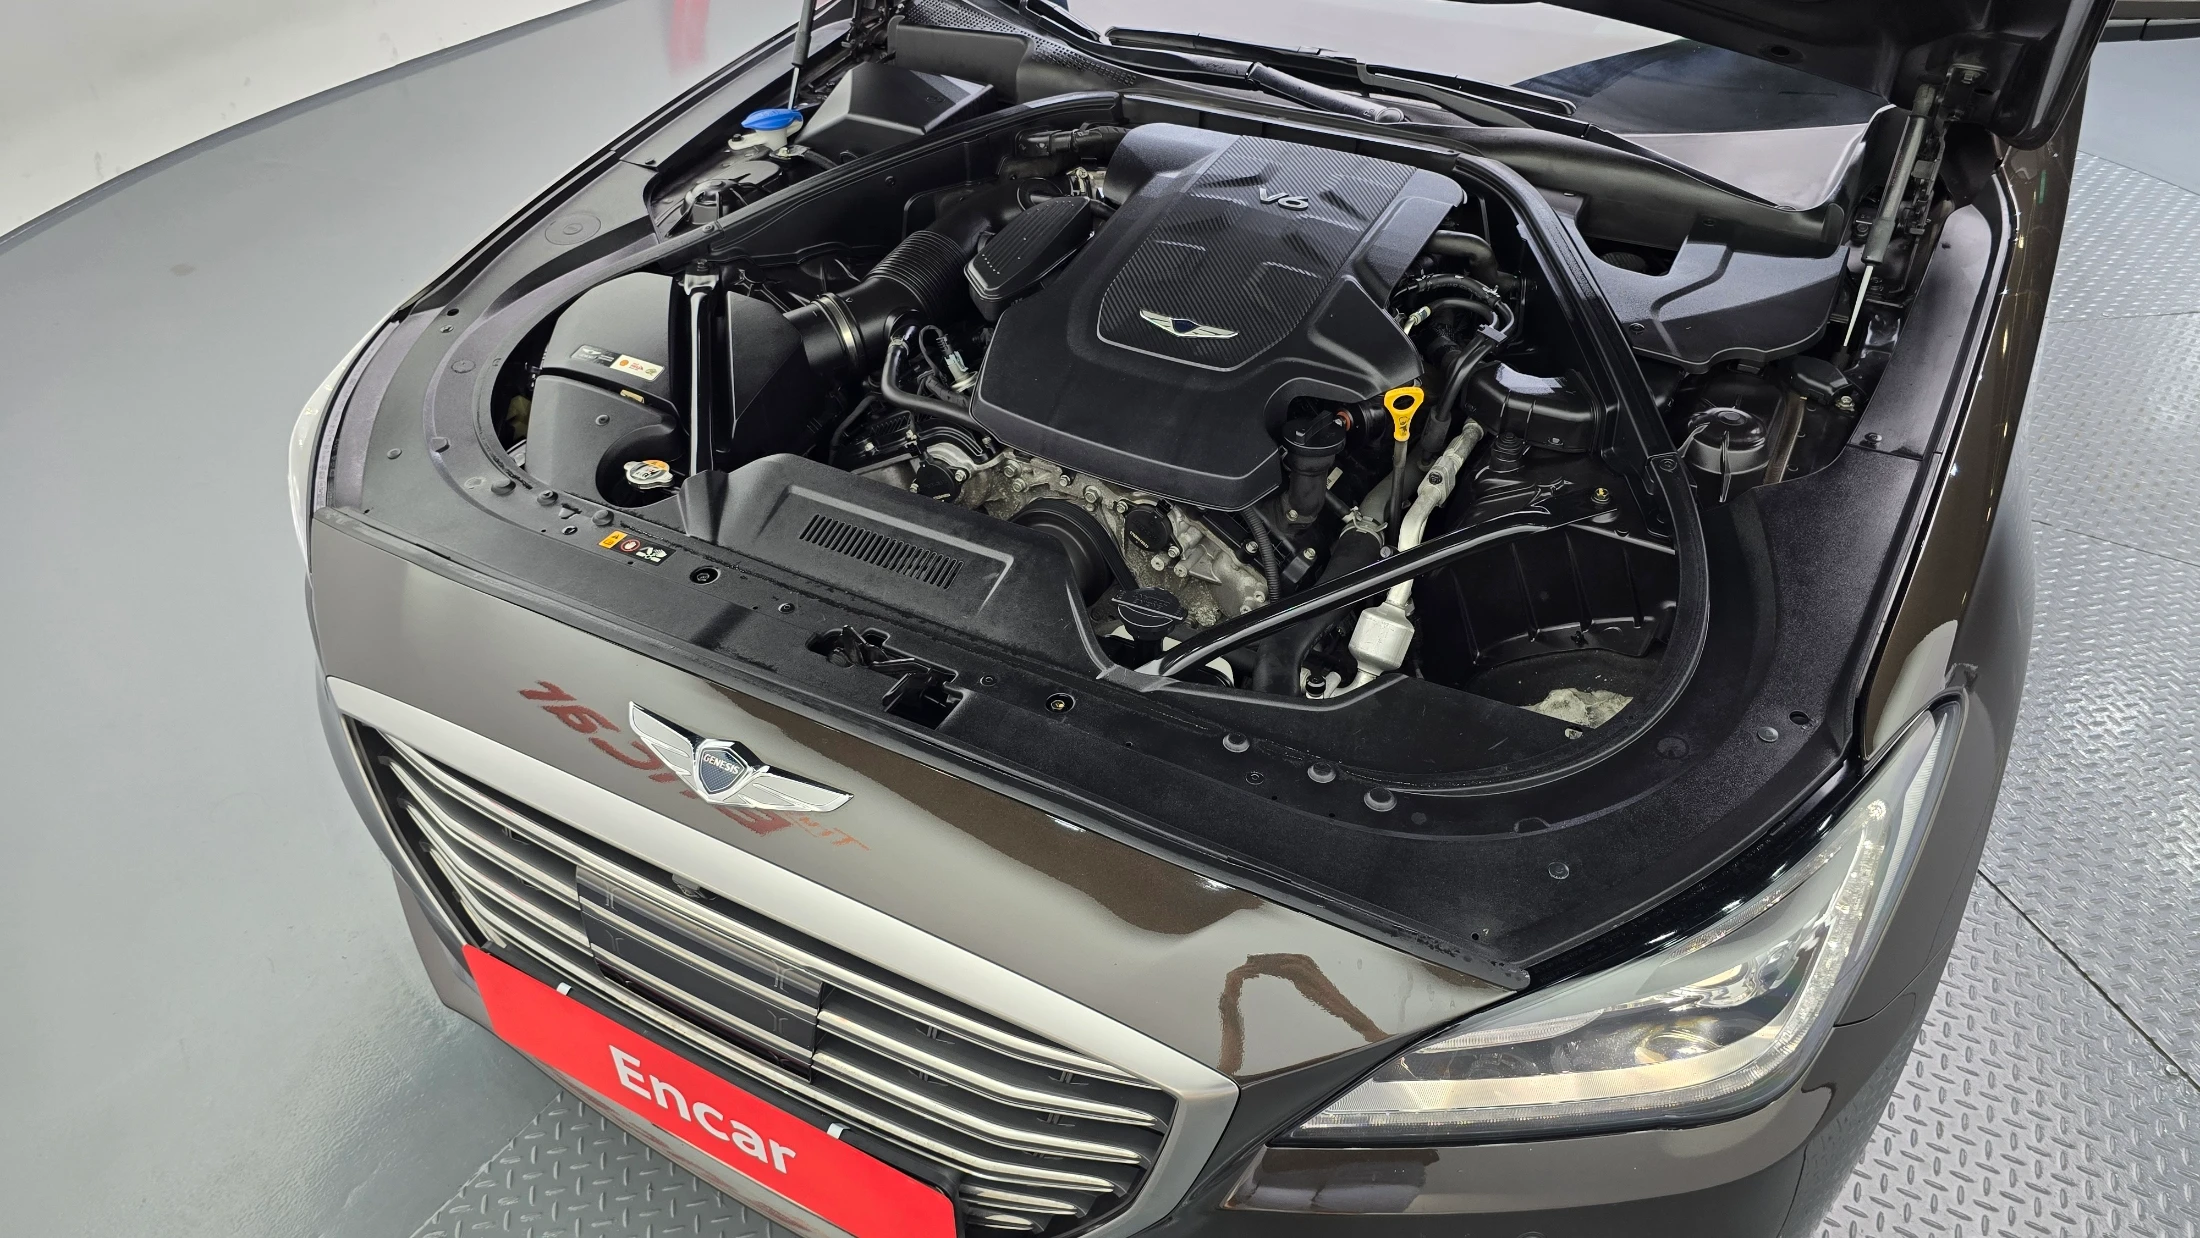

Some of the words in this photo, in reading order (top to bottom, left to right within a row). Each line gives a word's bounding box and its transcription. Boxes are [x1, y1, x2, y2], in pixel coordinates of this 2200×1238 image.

[1260, 188, 1308, 211] V6
[703, 753, 740, 775] GENESIS
[609, 1045, 796, 1174] Encar
